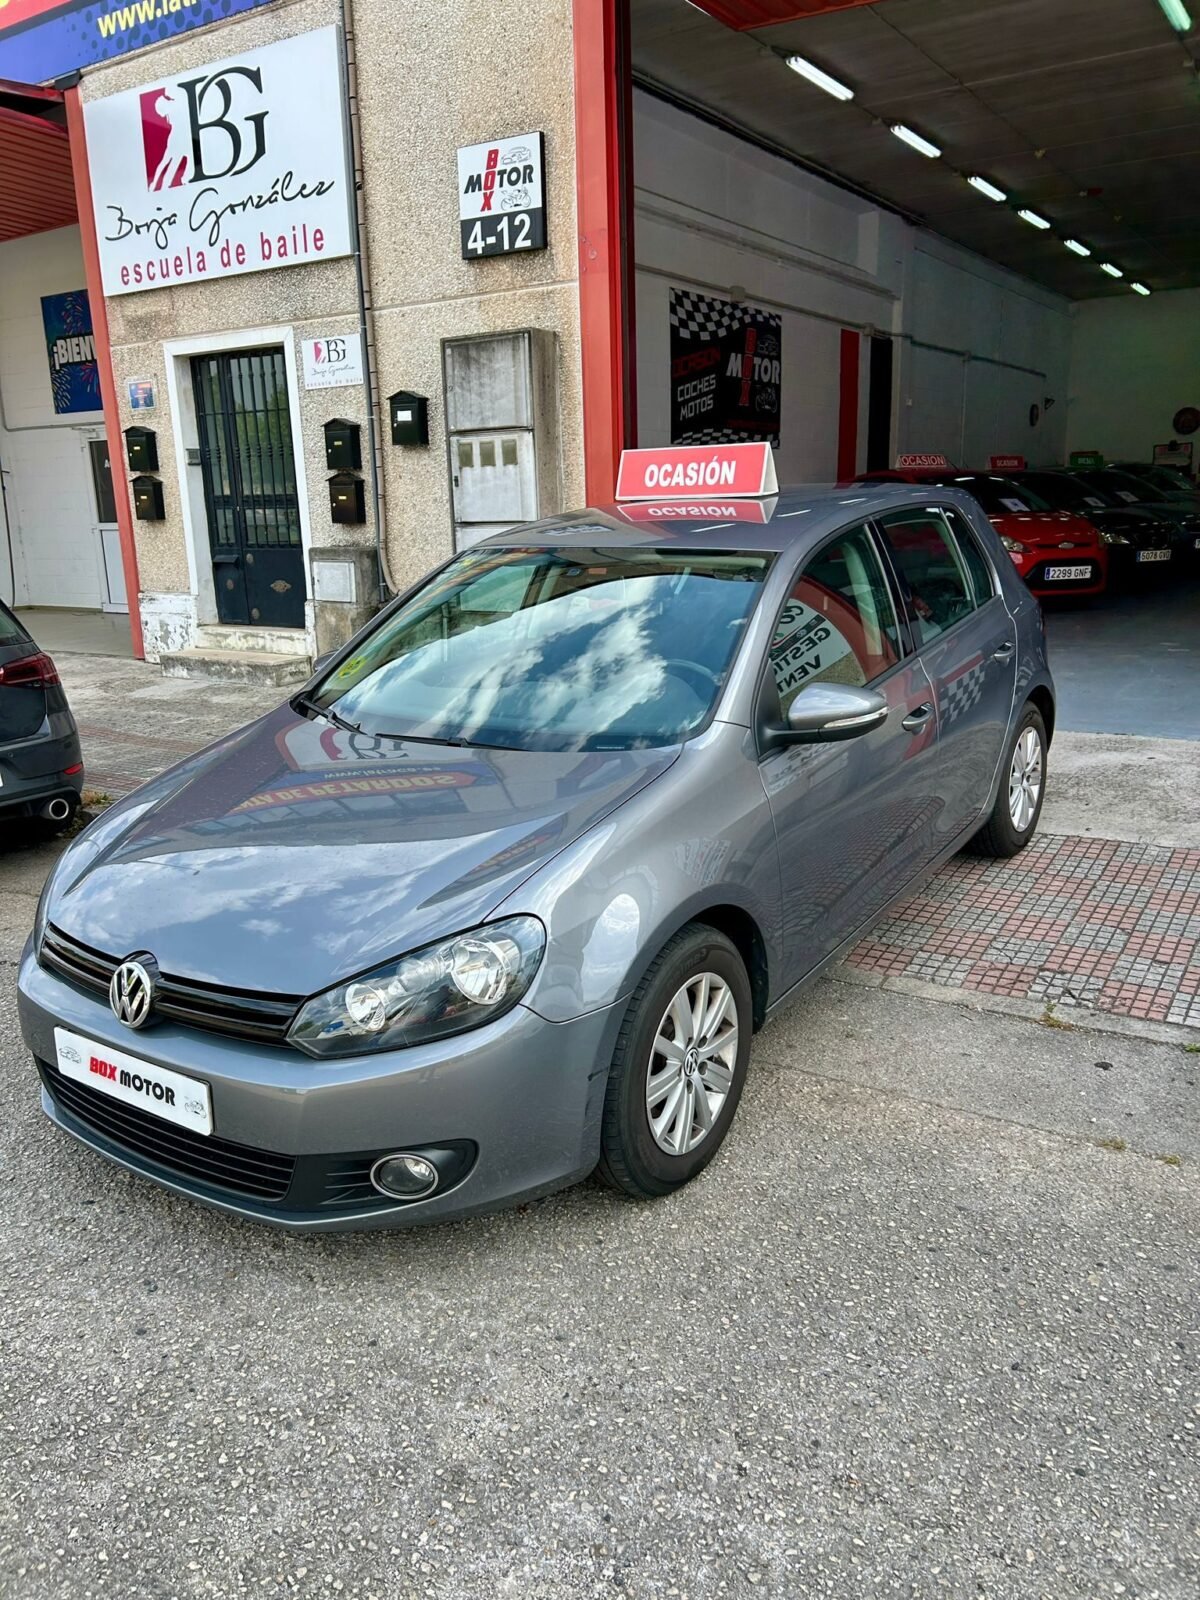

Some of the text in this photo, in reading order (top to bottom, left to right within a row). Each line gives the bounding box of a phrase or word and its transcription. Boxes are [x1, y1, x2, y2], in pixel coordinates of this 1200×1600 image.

[178, 66, 269, 184] BG
[464, 164, 534, 194] MOTOR
[480, 149, 499, 212] BOX
[105, 171, 335, 250] Borja González
[467, 213, 532, 254] 4-12
[121, 223, 325, 286] escuela de baile
[726, 352, 780, 384] MOTOR
[677, 374, 716, 402] COCHES
[680, 394, 714, 421] MOTOS
[644, 456, 736, 487] OCASIÓN
[1051, 569, 1072, 578] 2299
[89, 1056, 176, 1107] BOX MOTOR
